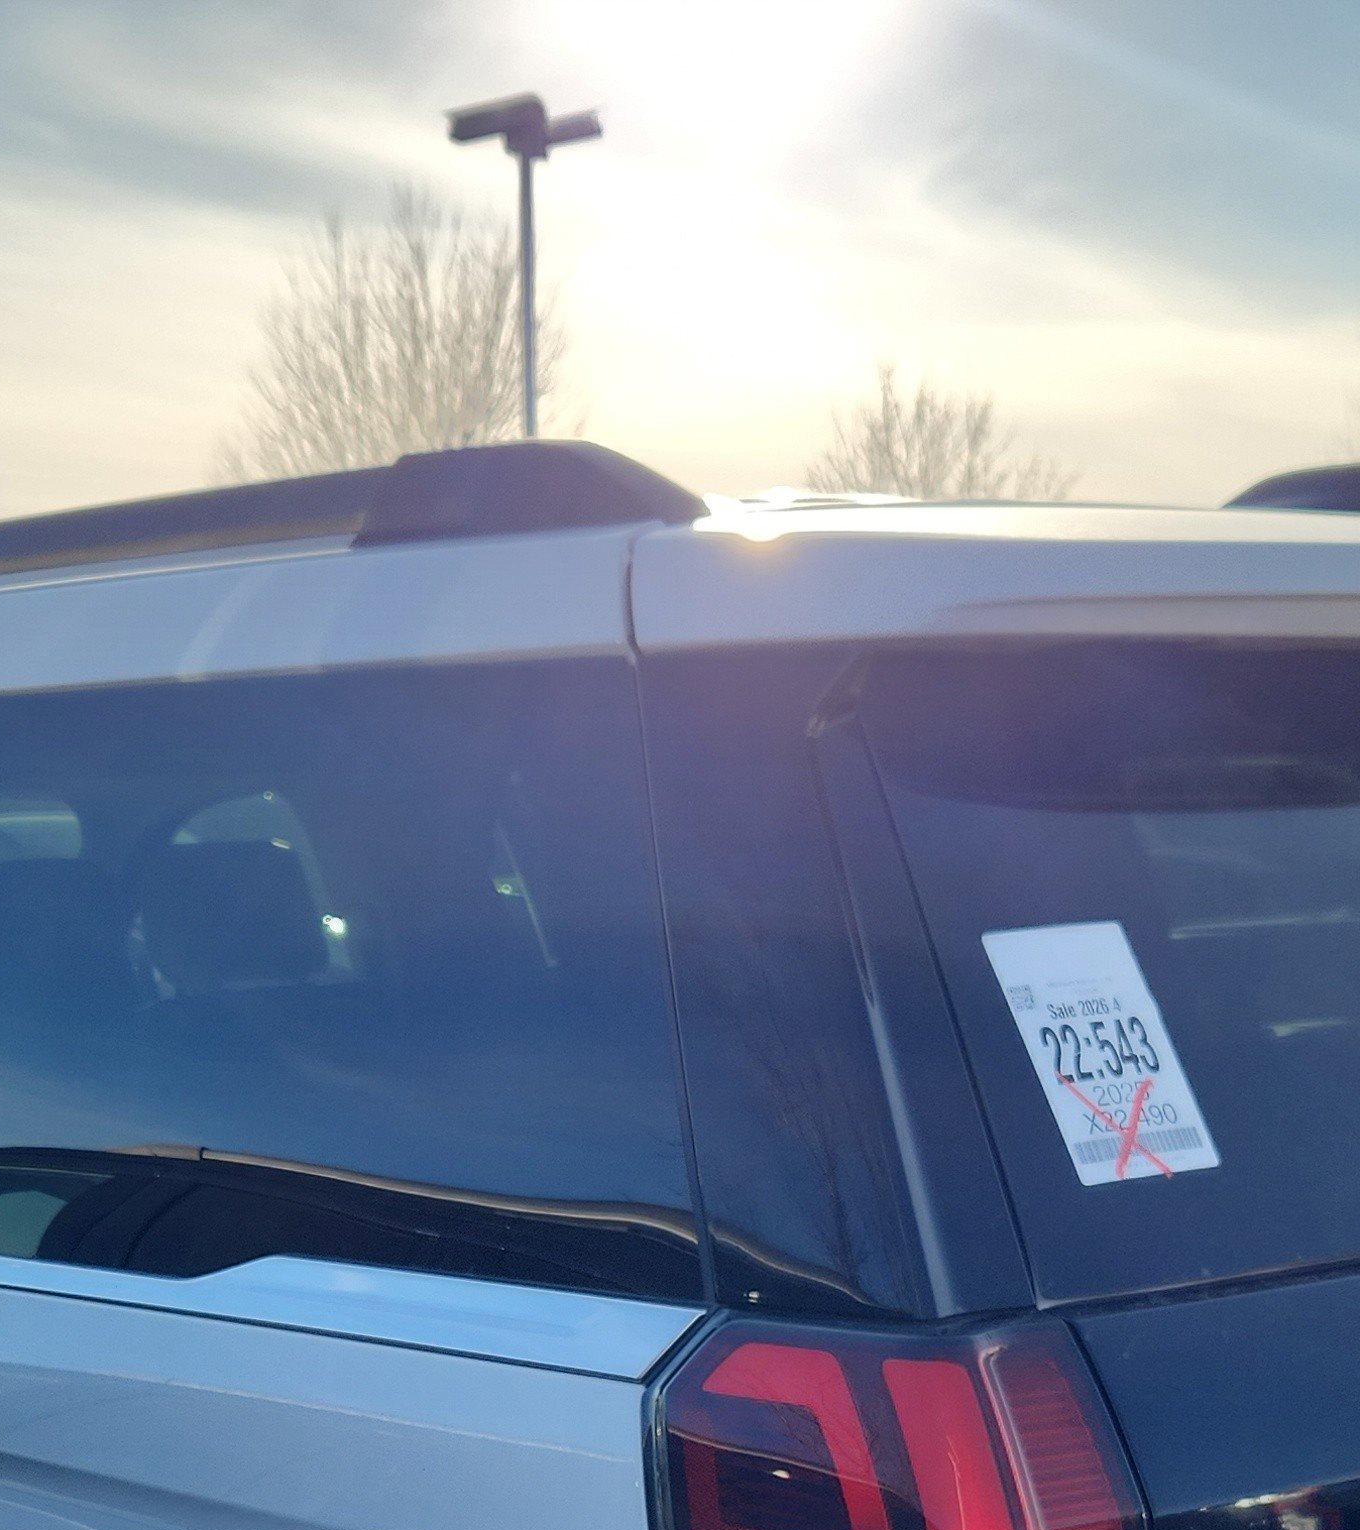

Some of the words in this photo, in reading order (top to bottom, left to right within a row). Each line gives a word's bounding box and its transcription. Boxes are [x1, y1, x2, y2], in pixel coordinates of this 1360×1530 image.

[1046, 1003, 1076, 1020] Sale
[1077, 999, 1110, 1017] 2026
[1039, 1016, 1160, 1085] 22:543
